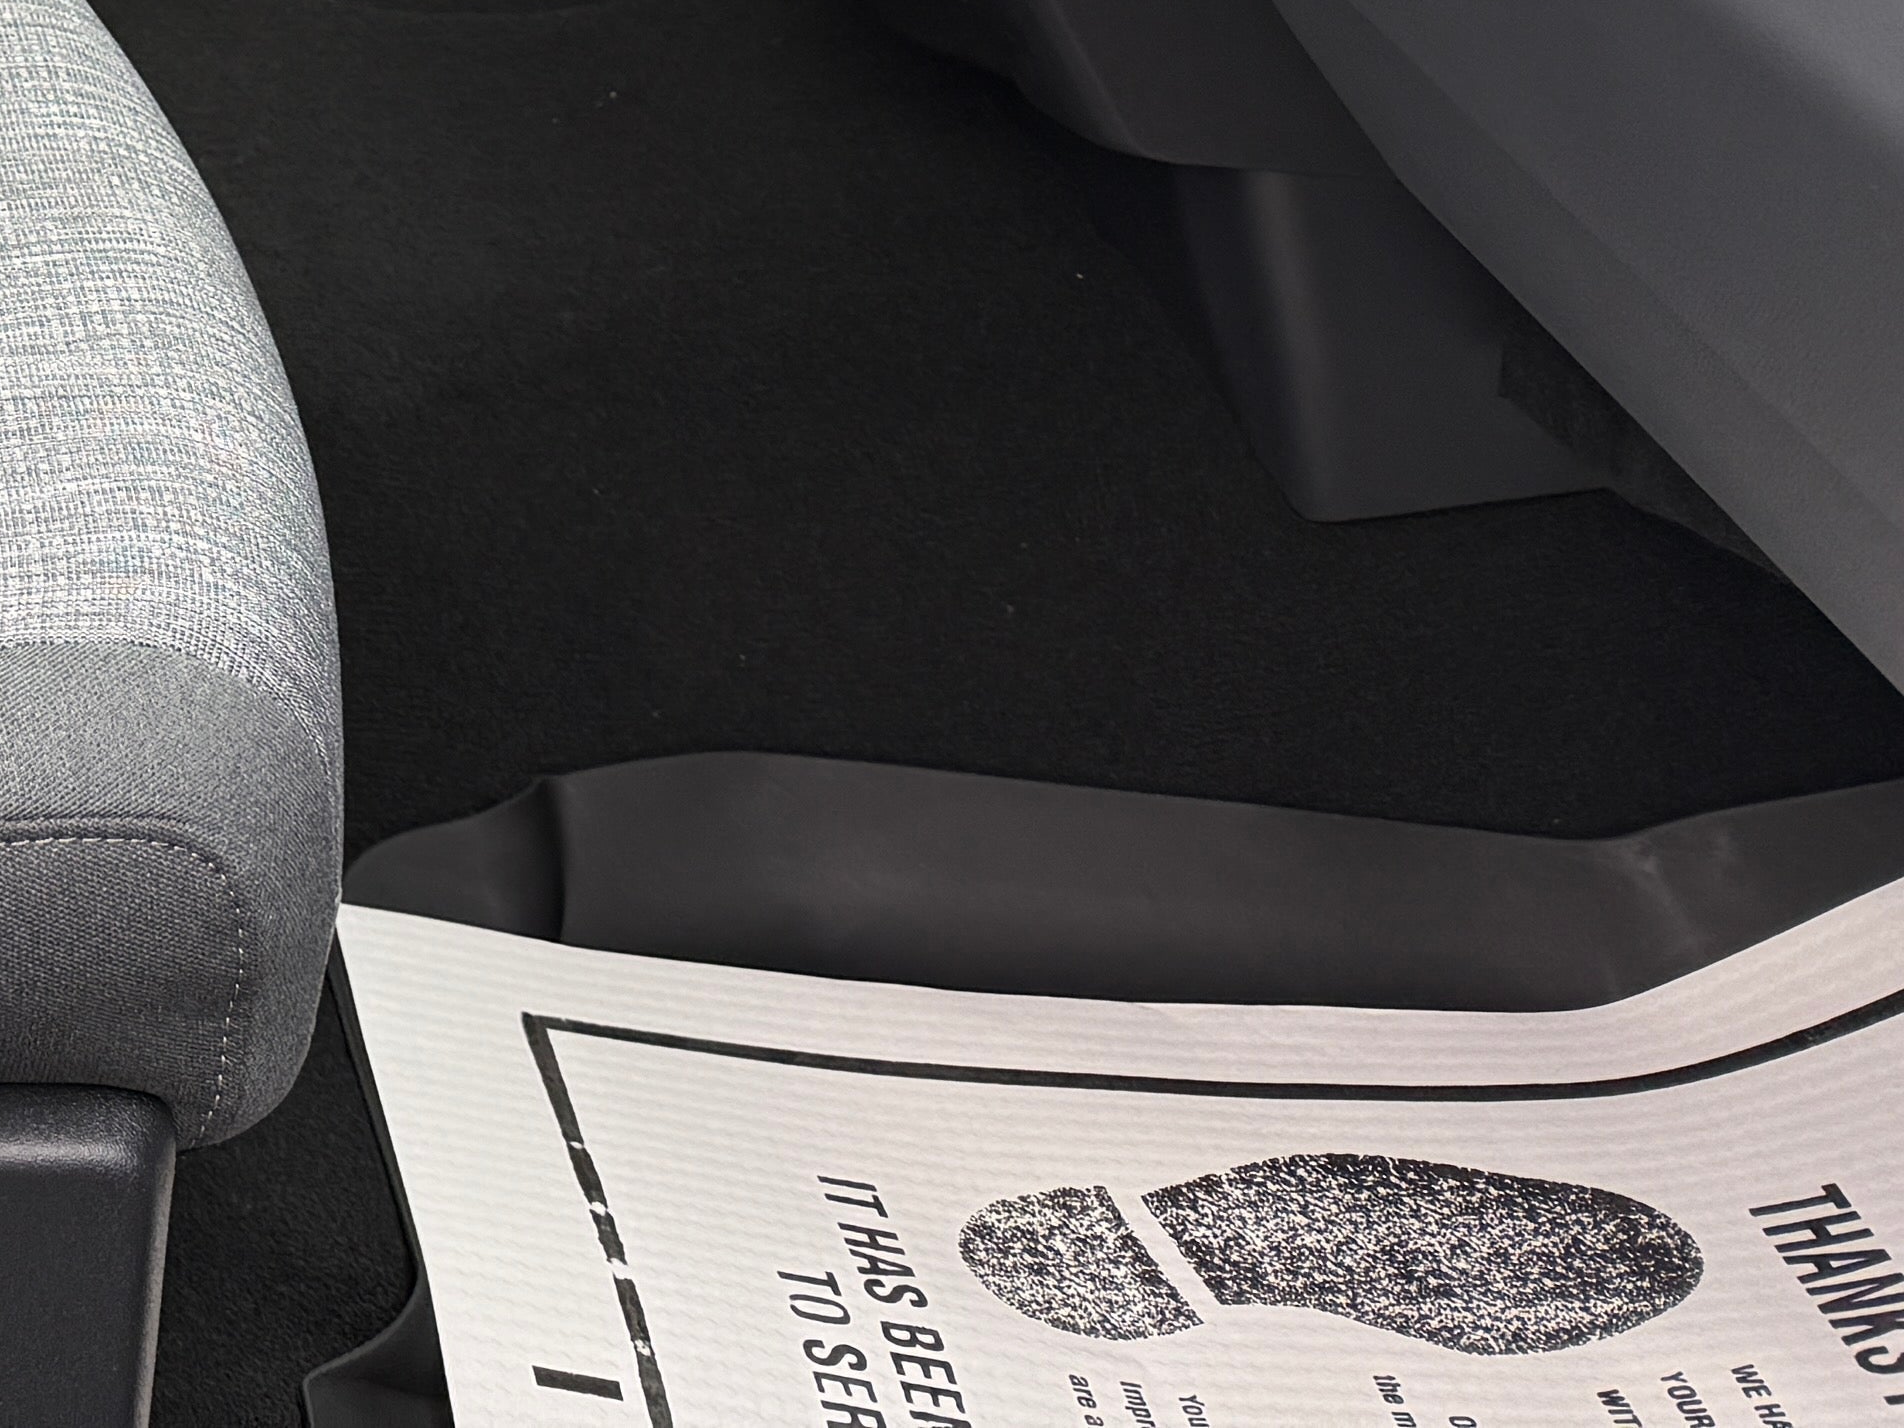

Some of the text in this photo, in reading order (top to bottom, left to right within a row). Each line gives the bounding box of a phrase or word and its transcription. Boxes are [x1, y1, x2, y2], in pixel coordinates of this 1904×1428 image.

[817, 1175, 889, 1219] IT
[837, 1222, 929, 1309] HAS
[776, 1270, 851, 1325] TO
[1068, 1374, 1097, 1409] are
[1373, 1375, 1404, 1405] the
[1660, 1371, 1717, 1428] YOUR
[1731, 1364, 1772, 1399] WE
[1119, 1381, 1158, 1428] Impr
